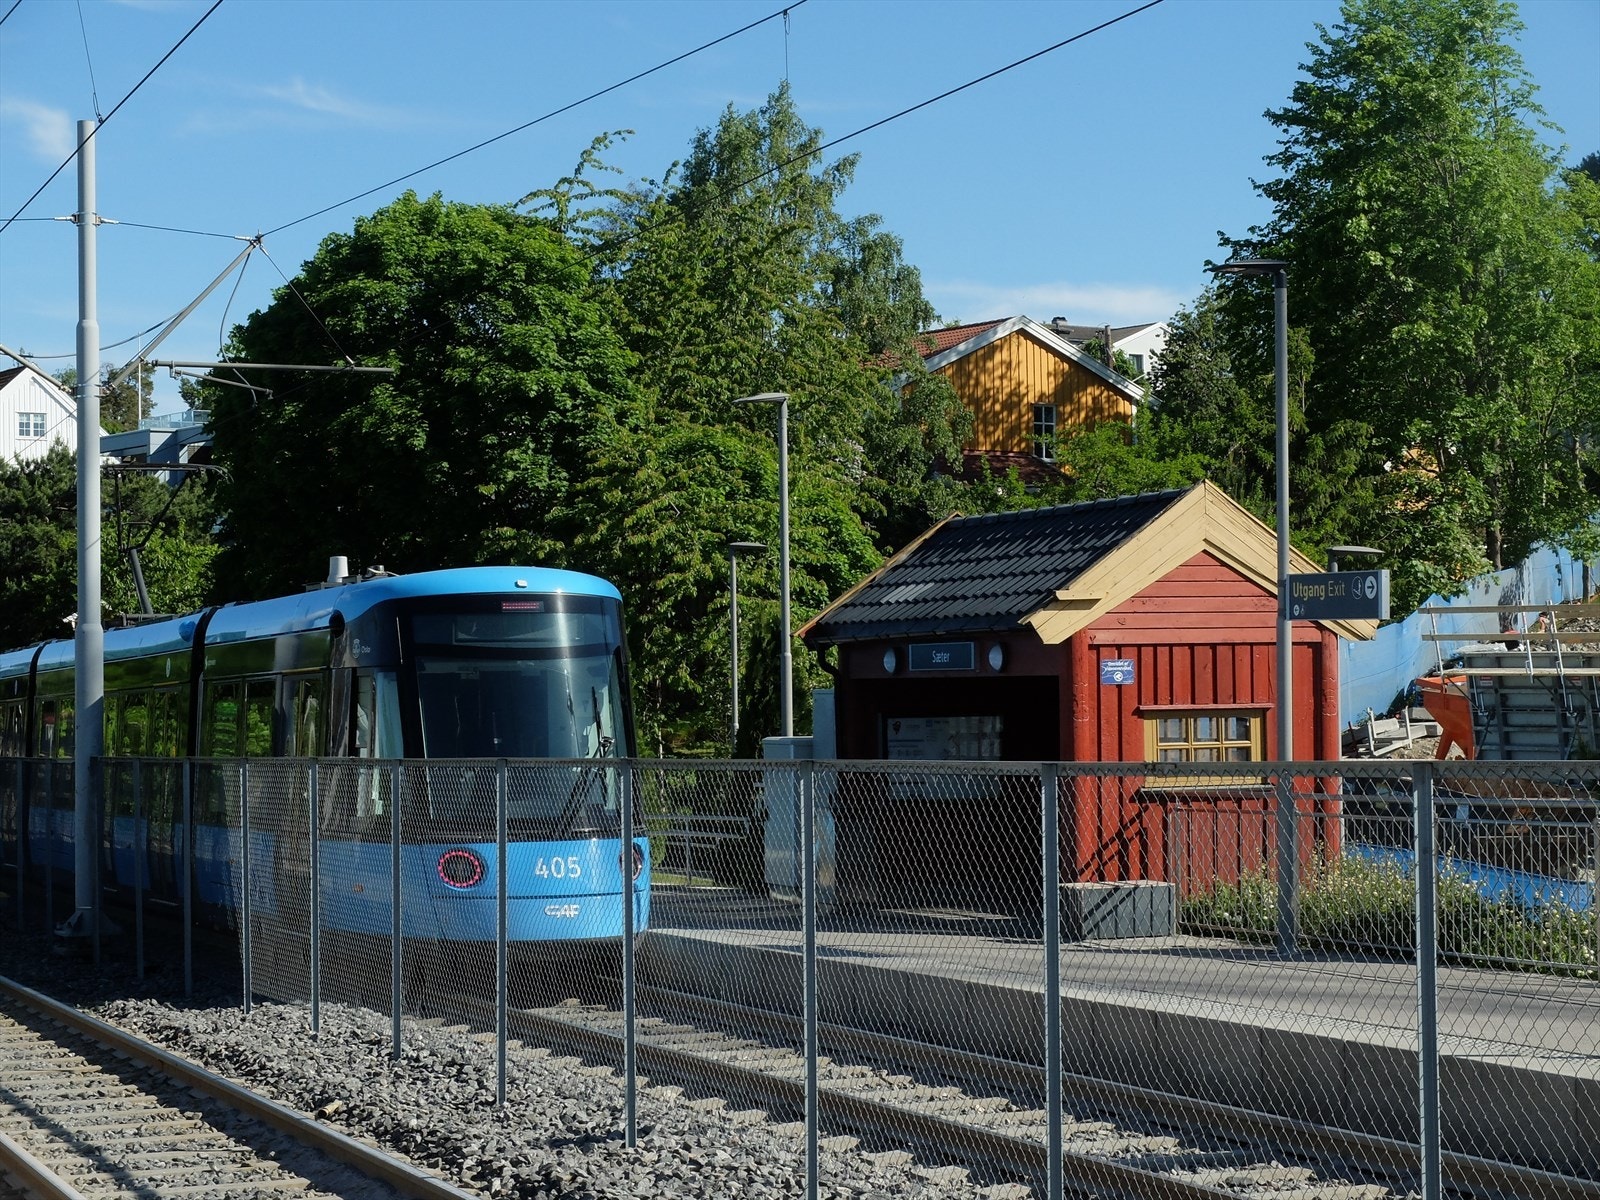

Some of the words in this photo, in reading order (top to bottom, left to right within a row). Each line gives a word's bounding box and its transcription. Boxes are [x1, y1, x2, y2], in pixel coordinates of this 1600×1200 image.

[1292, 582, 1325, 600] Utgang
[1328, 581, 1345, 597] Exit
[535, 856, 581, 879] 405
[544, 904, 580, 918] CAF
